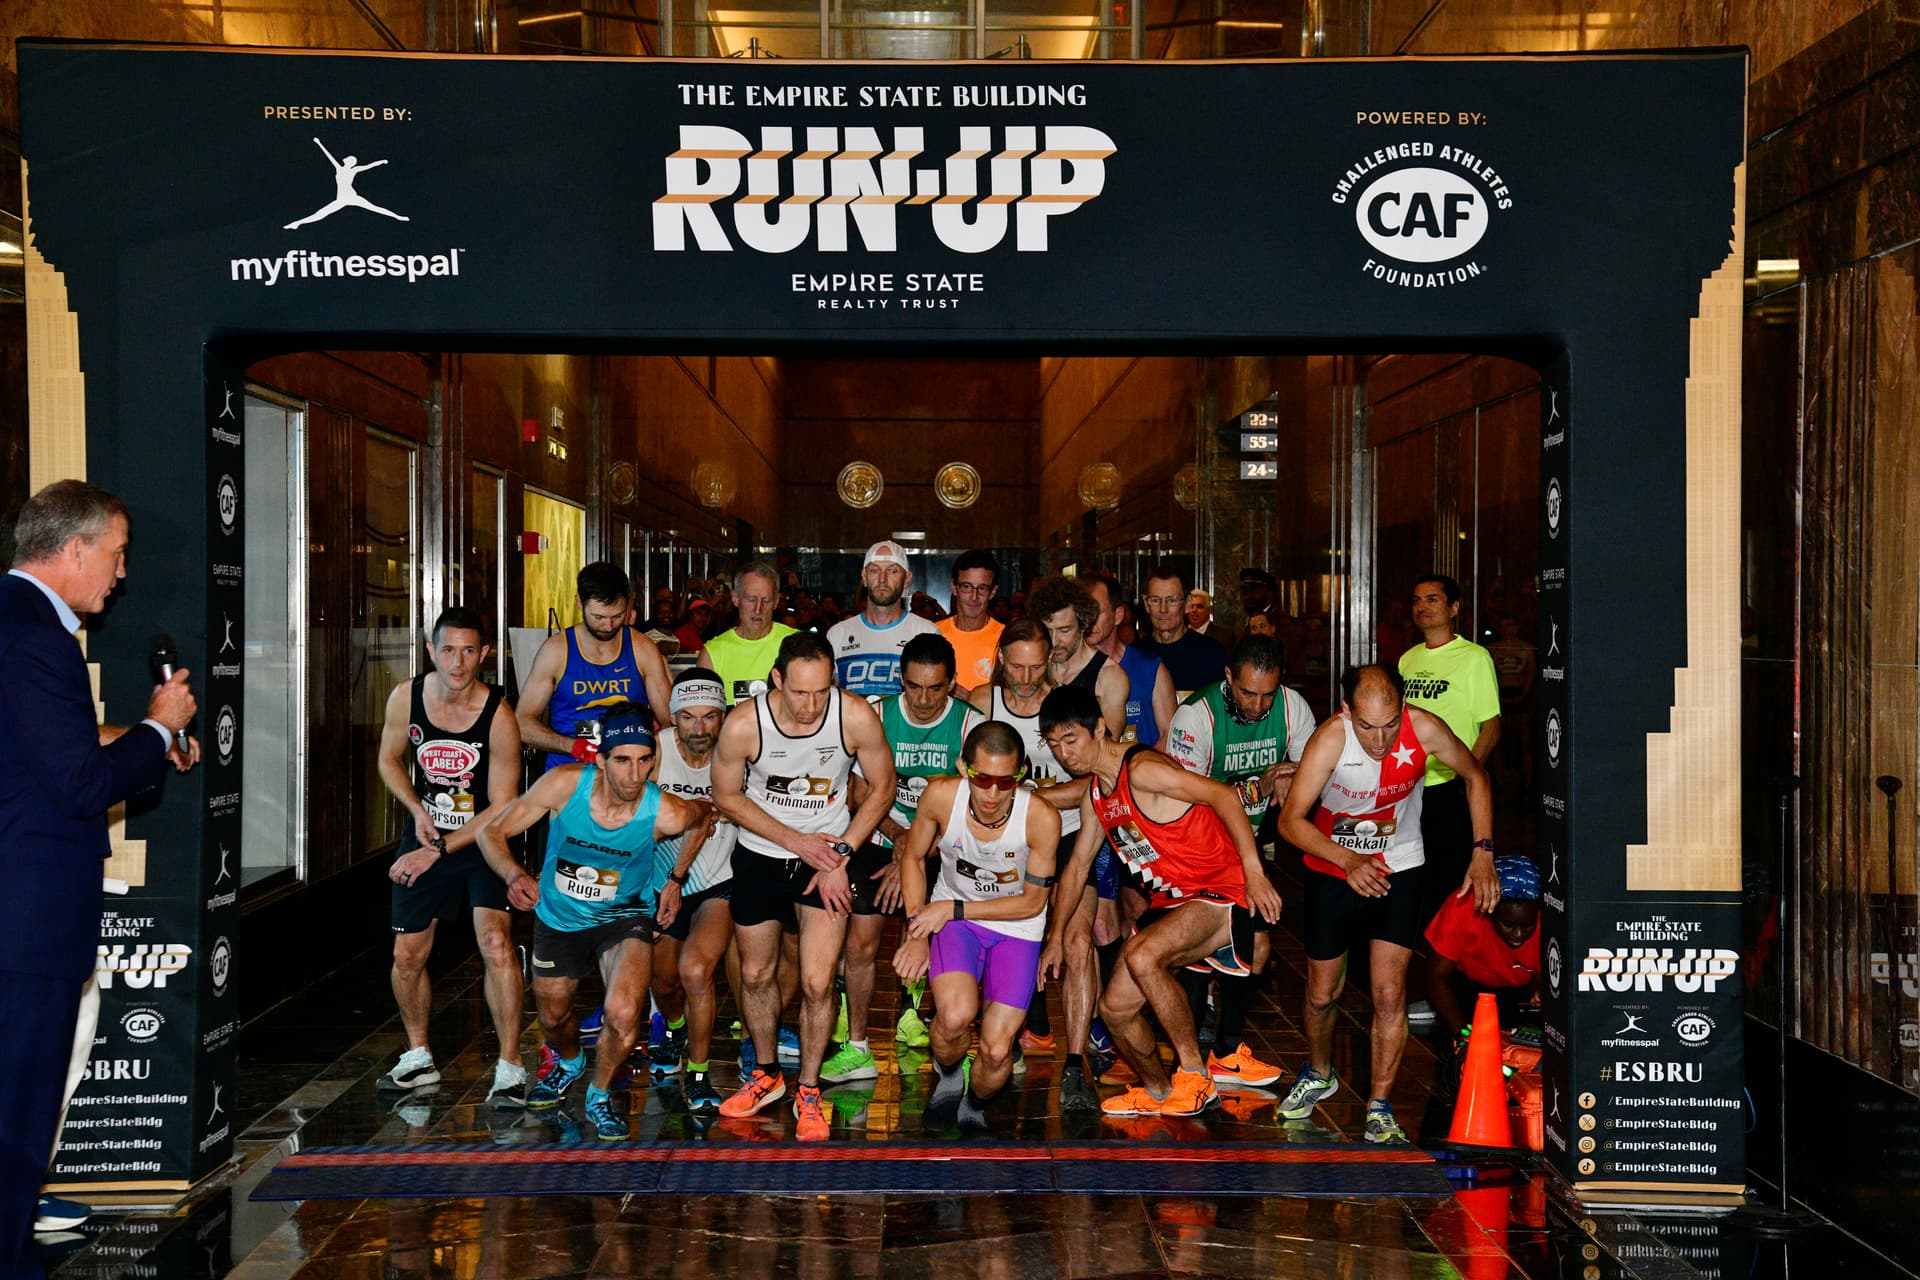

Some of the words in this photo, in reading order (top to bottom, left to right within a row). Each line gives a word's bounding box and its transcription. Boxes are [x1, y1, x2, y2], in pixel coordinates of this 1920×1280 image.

[678, 84, 735, 106] THE
[746, 85, 848, 107] EMPIRE
[859, 85, 942, 107] STATE
[953, 84, 1087, 106] BUILDING
[264, 106, 376, 120] PRESENTED
[383, 108, 412, 121] BY:
[1357, 111, 1450, 125] POWERED
[1458, 112, 1487, 126] BY:
[1332, 142, 1434, 205] CHALLENGED
[1439, 145, 1513, 210] ATHLETES
[651, 125, 1118, 254] RUN-UP
[1367, 192, 1474, 238] CAF
[1362, 259, 1481, 288] FOUNDATION
[791, 270, 894, 292] EMPIRE
[905, 273, 984, 292] STATE
[818, 299, 889, 309] REALTY
[900, 299, 960, 309] TRUST
[1247, 464, 1278, 476] 24-
[573, 679, 631, 695] DWRT
[1403, 679, 1450, 699] UN-UP
[623, 725, 634, 734] di
[423, 750, 440, 758] WEST
[442, 750, 463, 758] COAST
[895, 752, 947, 769] MEXICO
[1224, 748, 1277, 772] MEXICO
[426, 759, 465, 770] LABELS
[766, 792, 825, 809] Fruhmann
[566, 836, 632, 857] SCARPA
[1338, 836, 1388, 850] Bekkali
[568, 880, 601, 898] Ruga
[975, 882, 999, 892] Soh
[116, 918, 155, 928] STATE
[1616, 922, 1662, 932] EMPIRE
[1664, 922, 1702, 932] STATE
[101, 927, 140, 937] LDING
[1629, 932, 1688, 941] BUILDING
[96, 944, 192, 989] N-UP
[1578, 948, 1740, 993] RUN-UP
[129, 1020, 156, 1031] CAF
[1680, 1024, 1707, 1035] CAF
[1601, 1039, 1660, 1048] myfitnesspal
[1600, 1062, 1703, 1083] #ESBRU
[1604, 1118, 1717, 1131] @EmpireStateBldg
[1603, 1140, 1717, 1154] @EmpireStateBldg
[56, 1161, 161, 1174] EmpireStateBldg
[1603, 1162, 1717, 1175] @EmpireStateBldg
